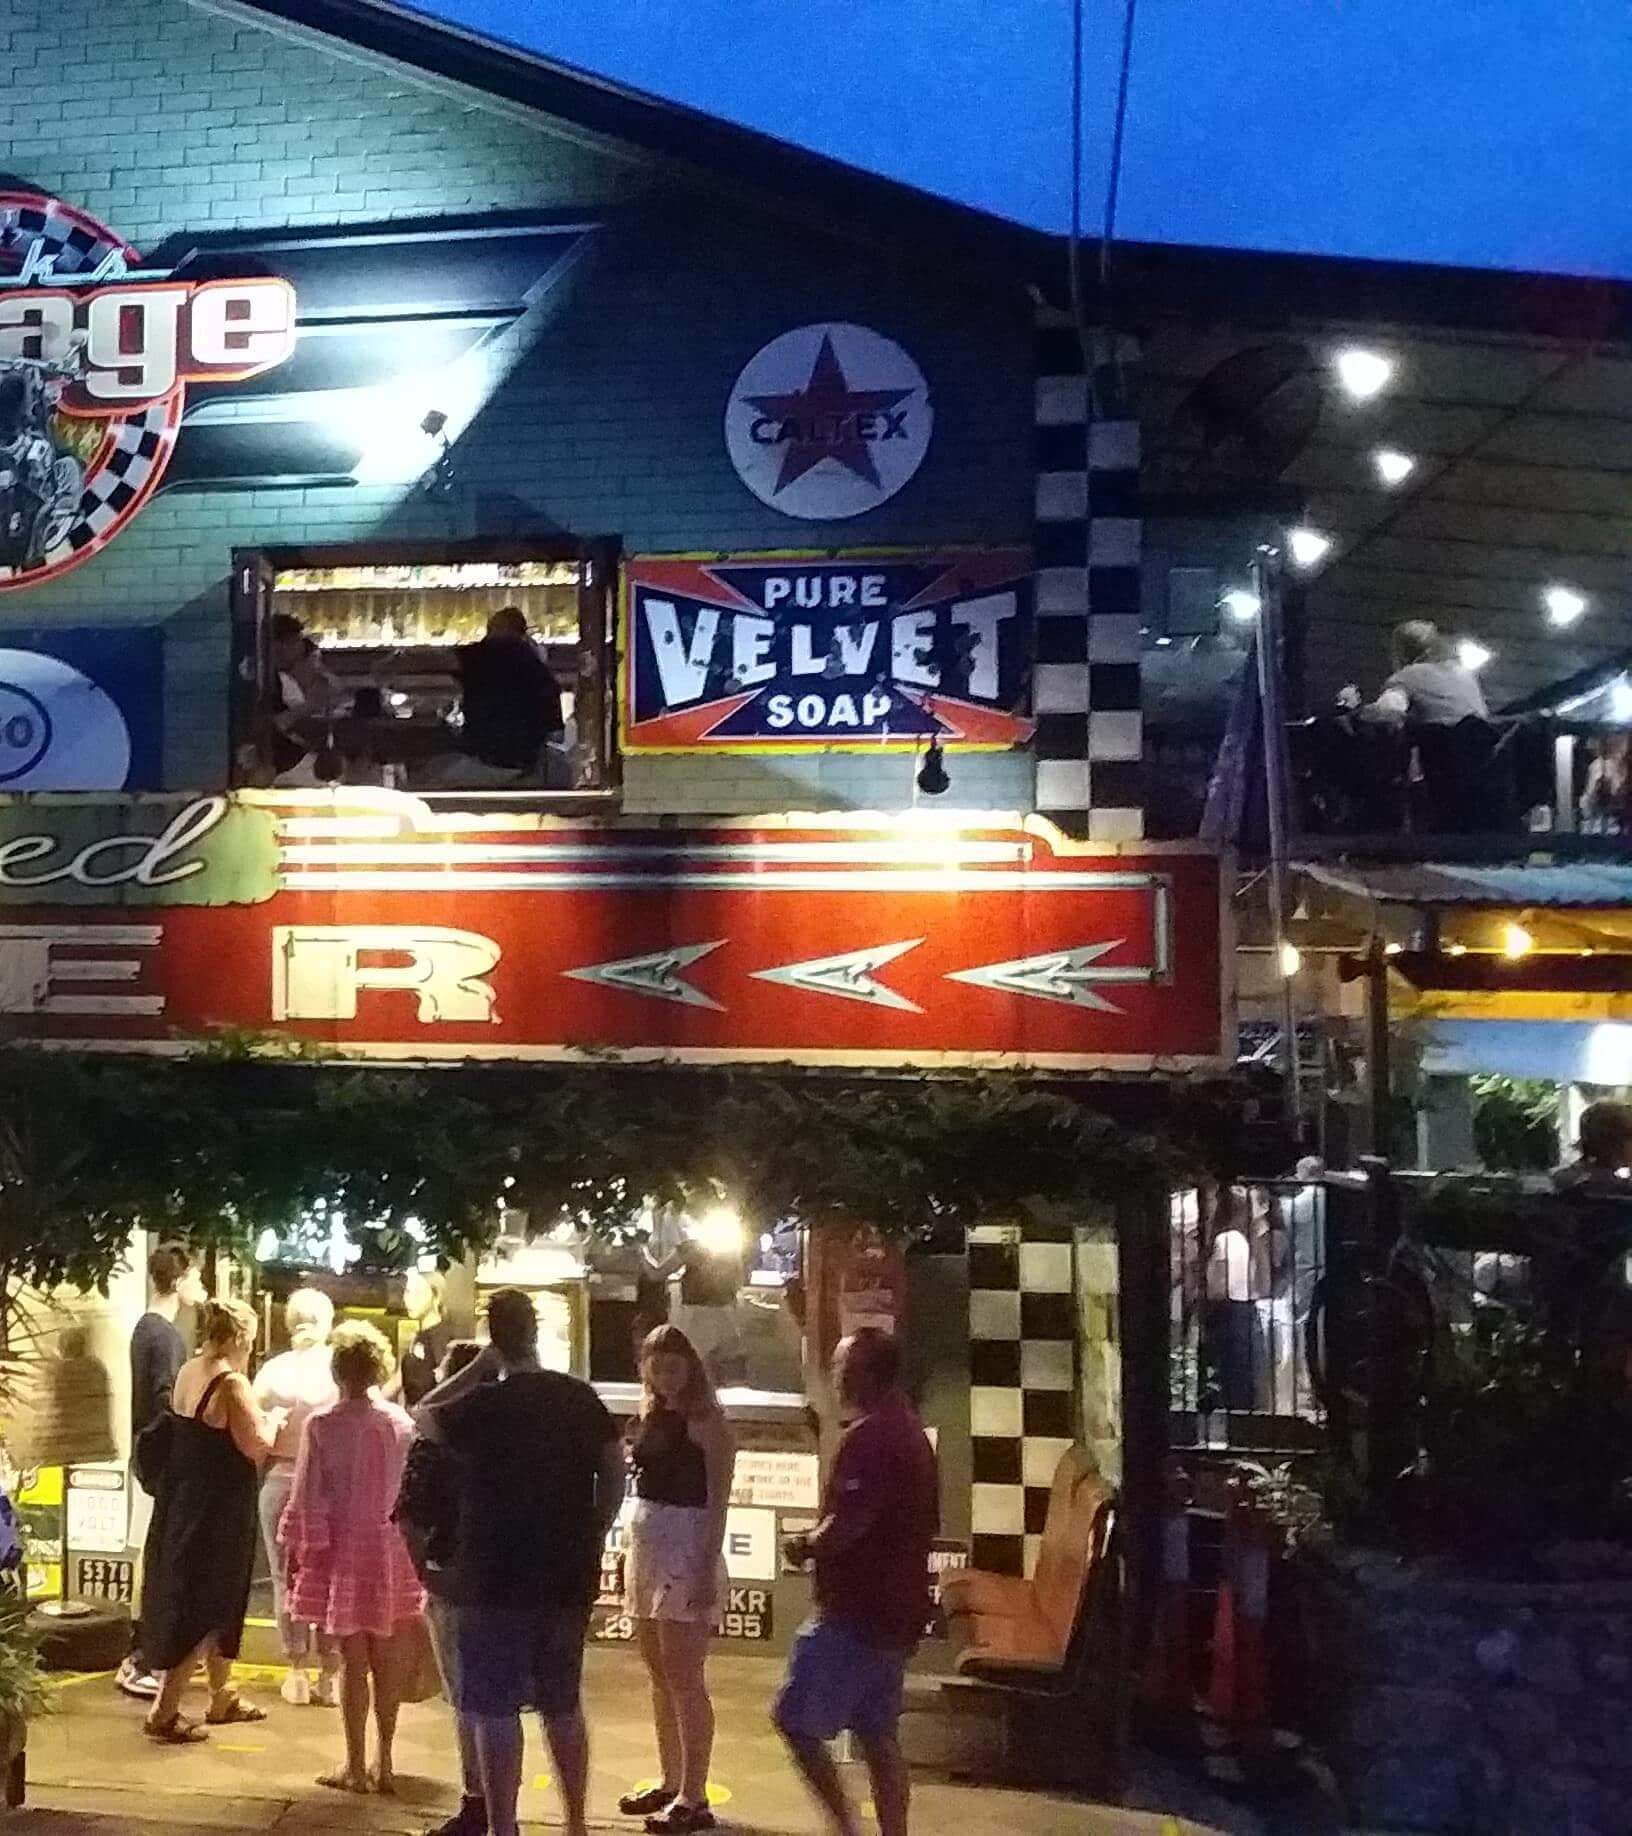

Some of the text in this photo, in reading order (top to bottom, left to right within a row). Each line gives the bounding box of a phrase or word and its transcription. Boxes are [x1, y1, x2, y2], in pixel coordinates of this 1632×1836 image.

[749, 409, 909, 445] CALTEX
[765, 575, 888, 609] PURE
[643, 591, 1017, 707] VELVET
[768, 694, 891, 728] SOAP
[82, 1560, 130, 1582] 5370
[724, 1588, 766, 1614] KR
